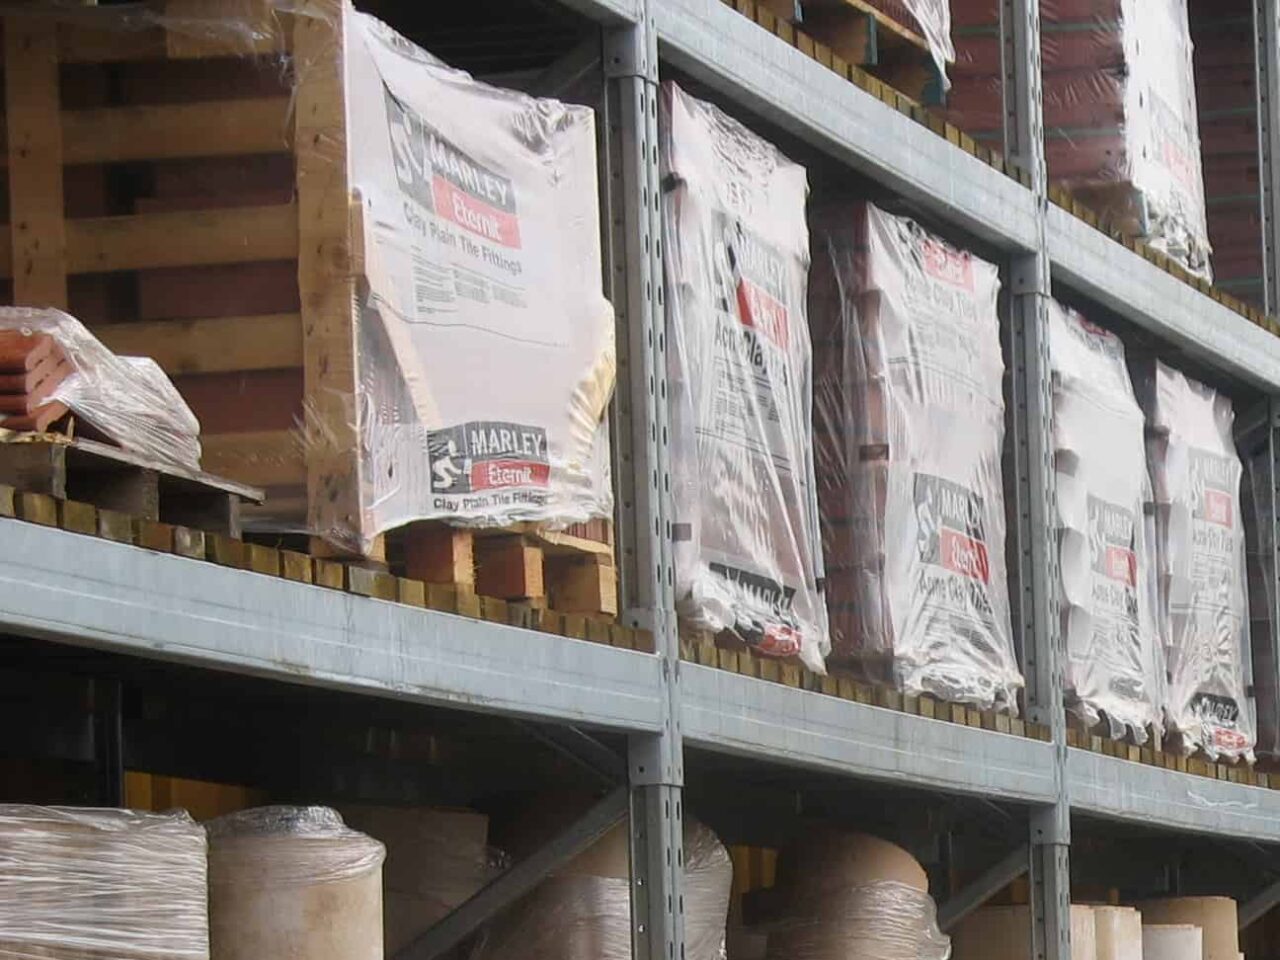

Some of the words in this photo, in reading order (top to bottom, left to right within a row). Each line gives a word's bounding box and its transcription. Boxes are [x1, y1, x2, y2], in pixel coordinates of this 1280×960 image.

[429, 133, 507, 205] MARLEY
[451, 191, 502, 240] Eternit
[403, 201, 427, 238] Clay
[428, 221, 457, 247] Plain
[460, 235, 480, 258] Tile
[481, 245, 523, 277] Fittings
[471, 428, 543, 457] MARLEY
[487, 463, 533, 485] Eternit
[433, 498, 459, 512] Clay
